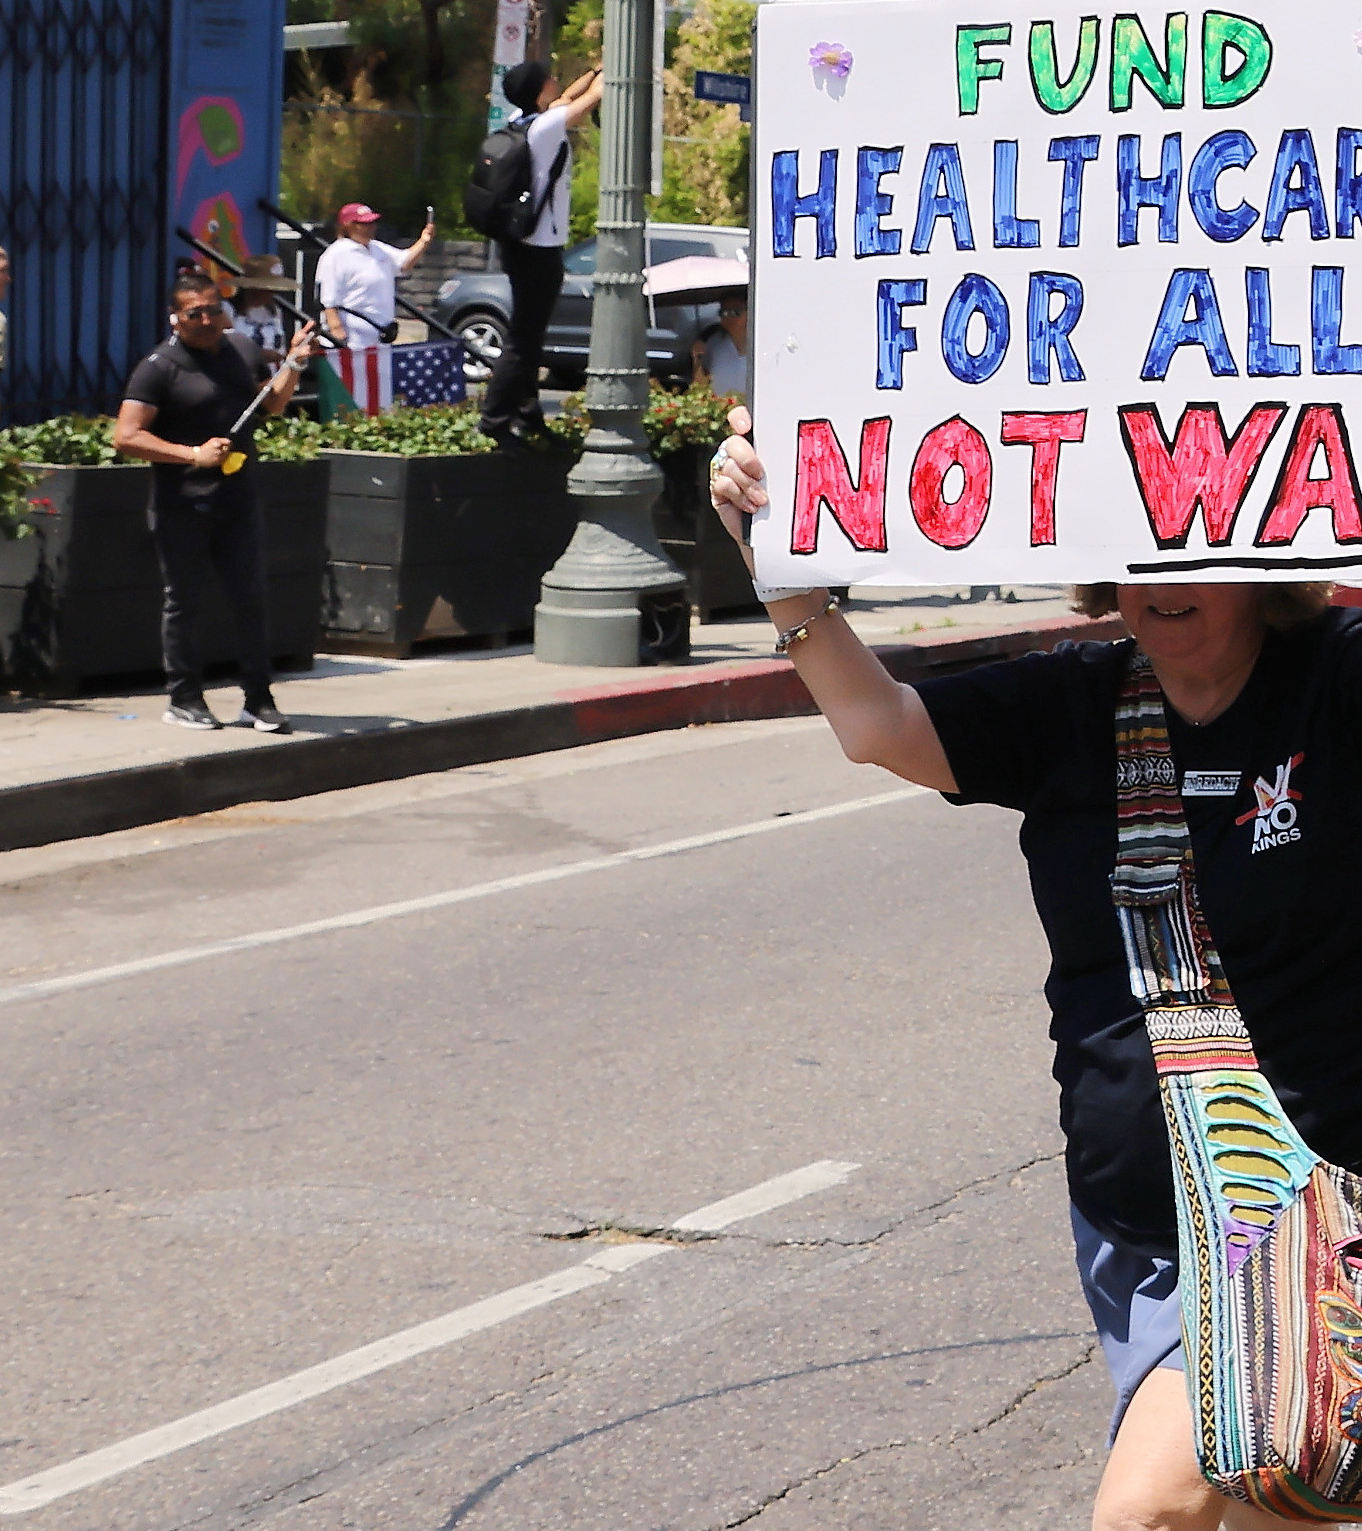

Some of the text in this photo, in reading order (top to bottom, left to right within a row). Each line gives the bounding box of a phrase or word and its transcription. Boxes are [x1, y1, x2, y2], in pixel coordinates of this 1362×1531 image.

[955, 10, 1272, 116] FUND
[876, 272, 1085, 390] FOR
[791, 408, 1087, 555] NOT
[1251, 828, 1302, 855] KINGS
[1254, 801, 1297, 842] NO
